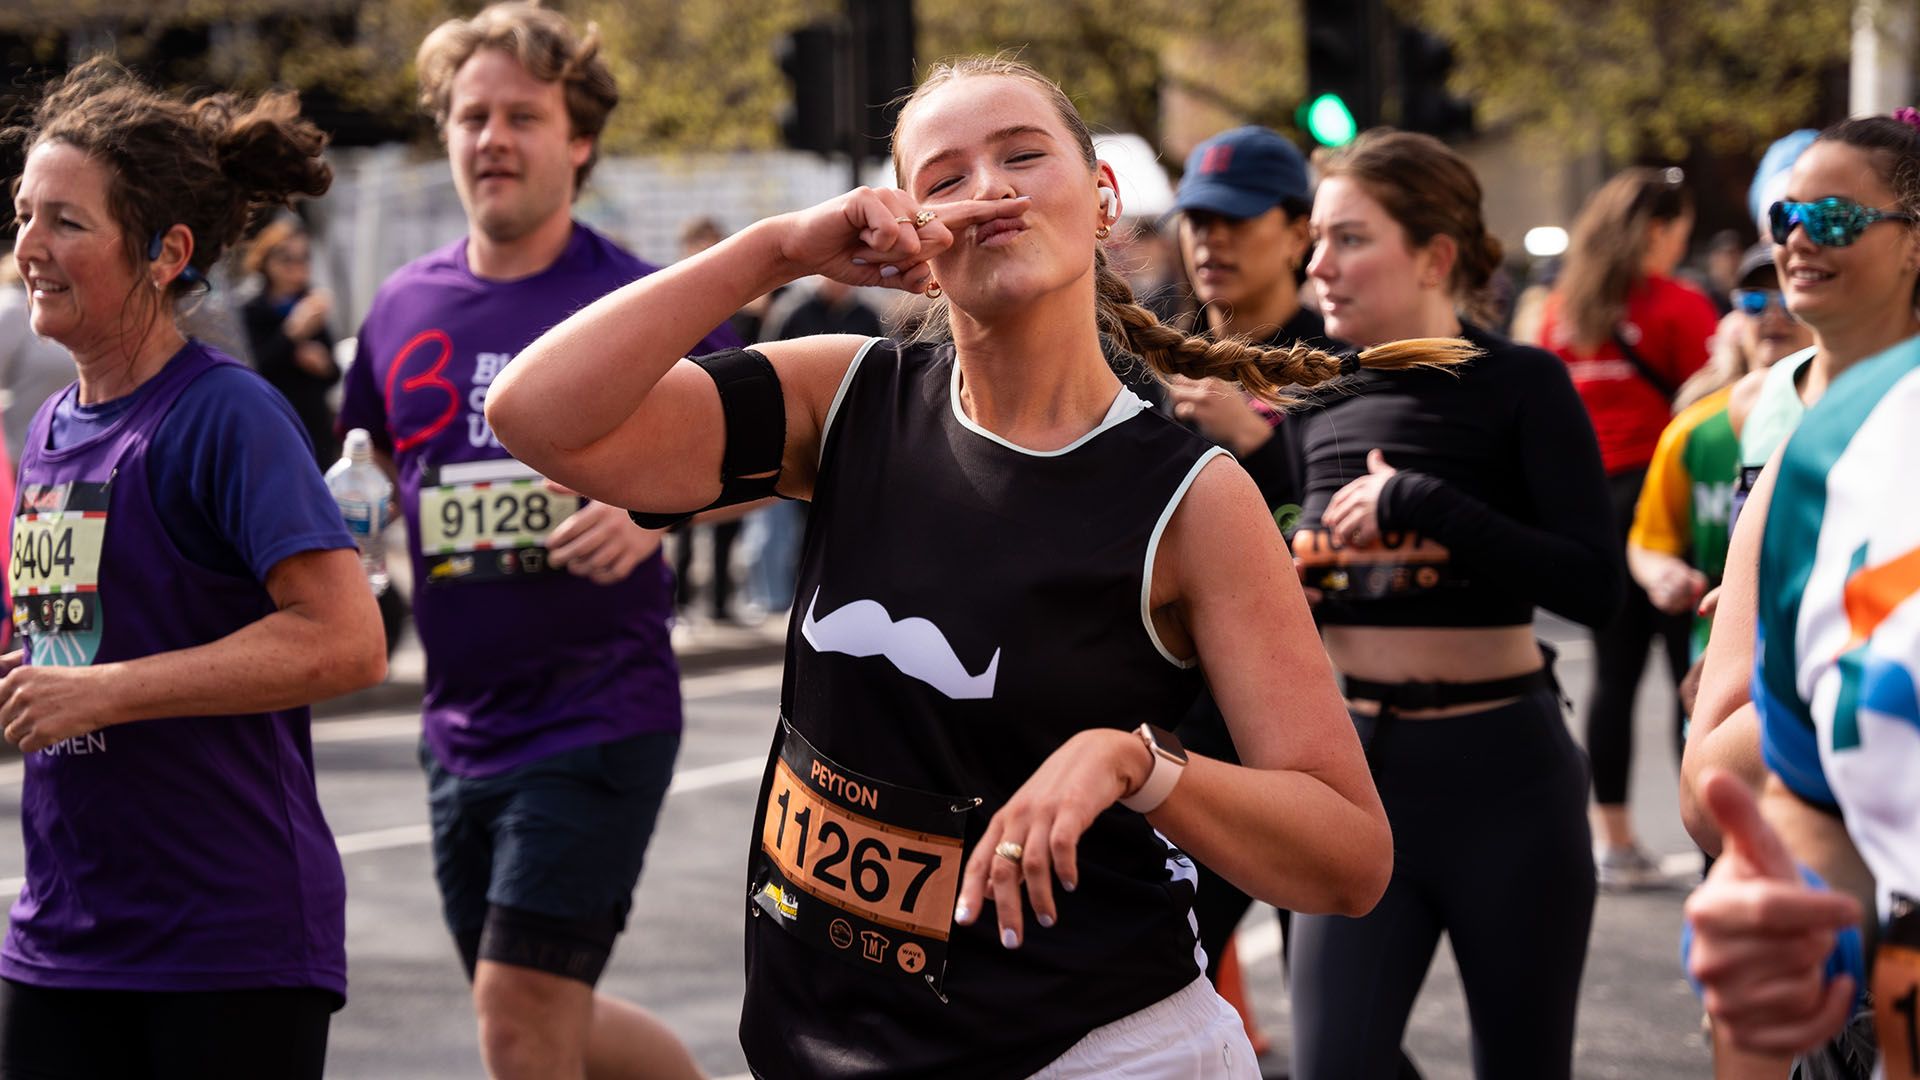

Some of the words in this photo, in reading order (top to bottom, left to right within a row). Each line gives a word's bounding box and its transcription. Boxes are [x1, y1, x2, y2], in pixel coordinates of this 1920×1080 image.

[467, 413, 499, 448] U
[441, 492, 550, 538] 9128
[13, 527, 74, 580] 8404
[38, 731, 106, 757] OMEN
[811, 759, 878, 810] PEYTON
[776, 788, 942, 914] 11267
[869, 938, 878, 957] M
[902, 948, 922, 958] WAVE
[906, 957, 915, 969] 4
